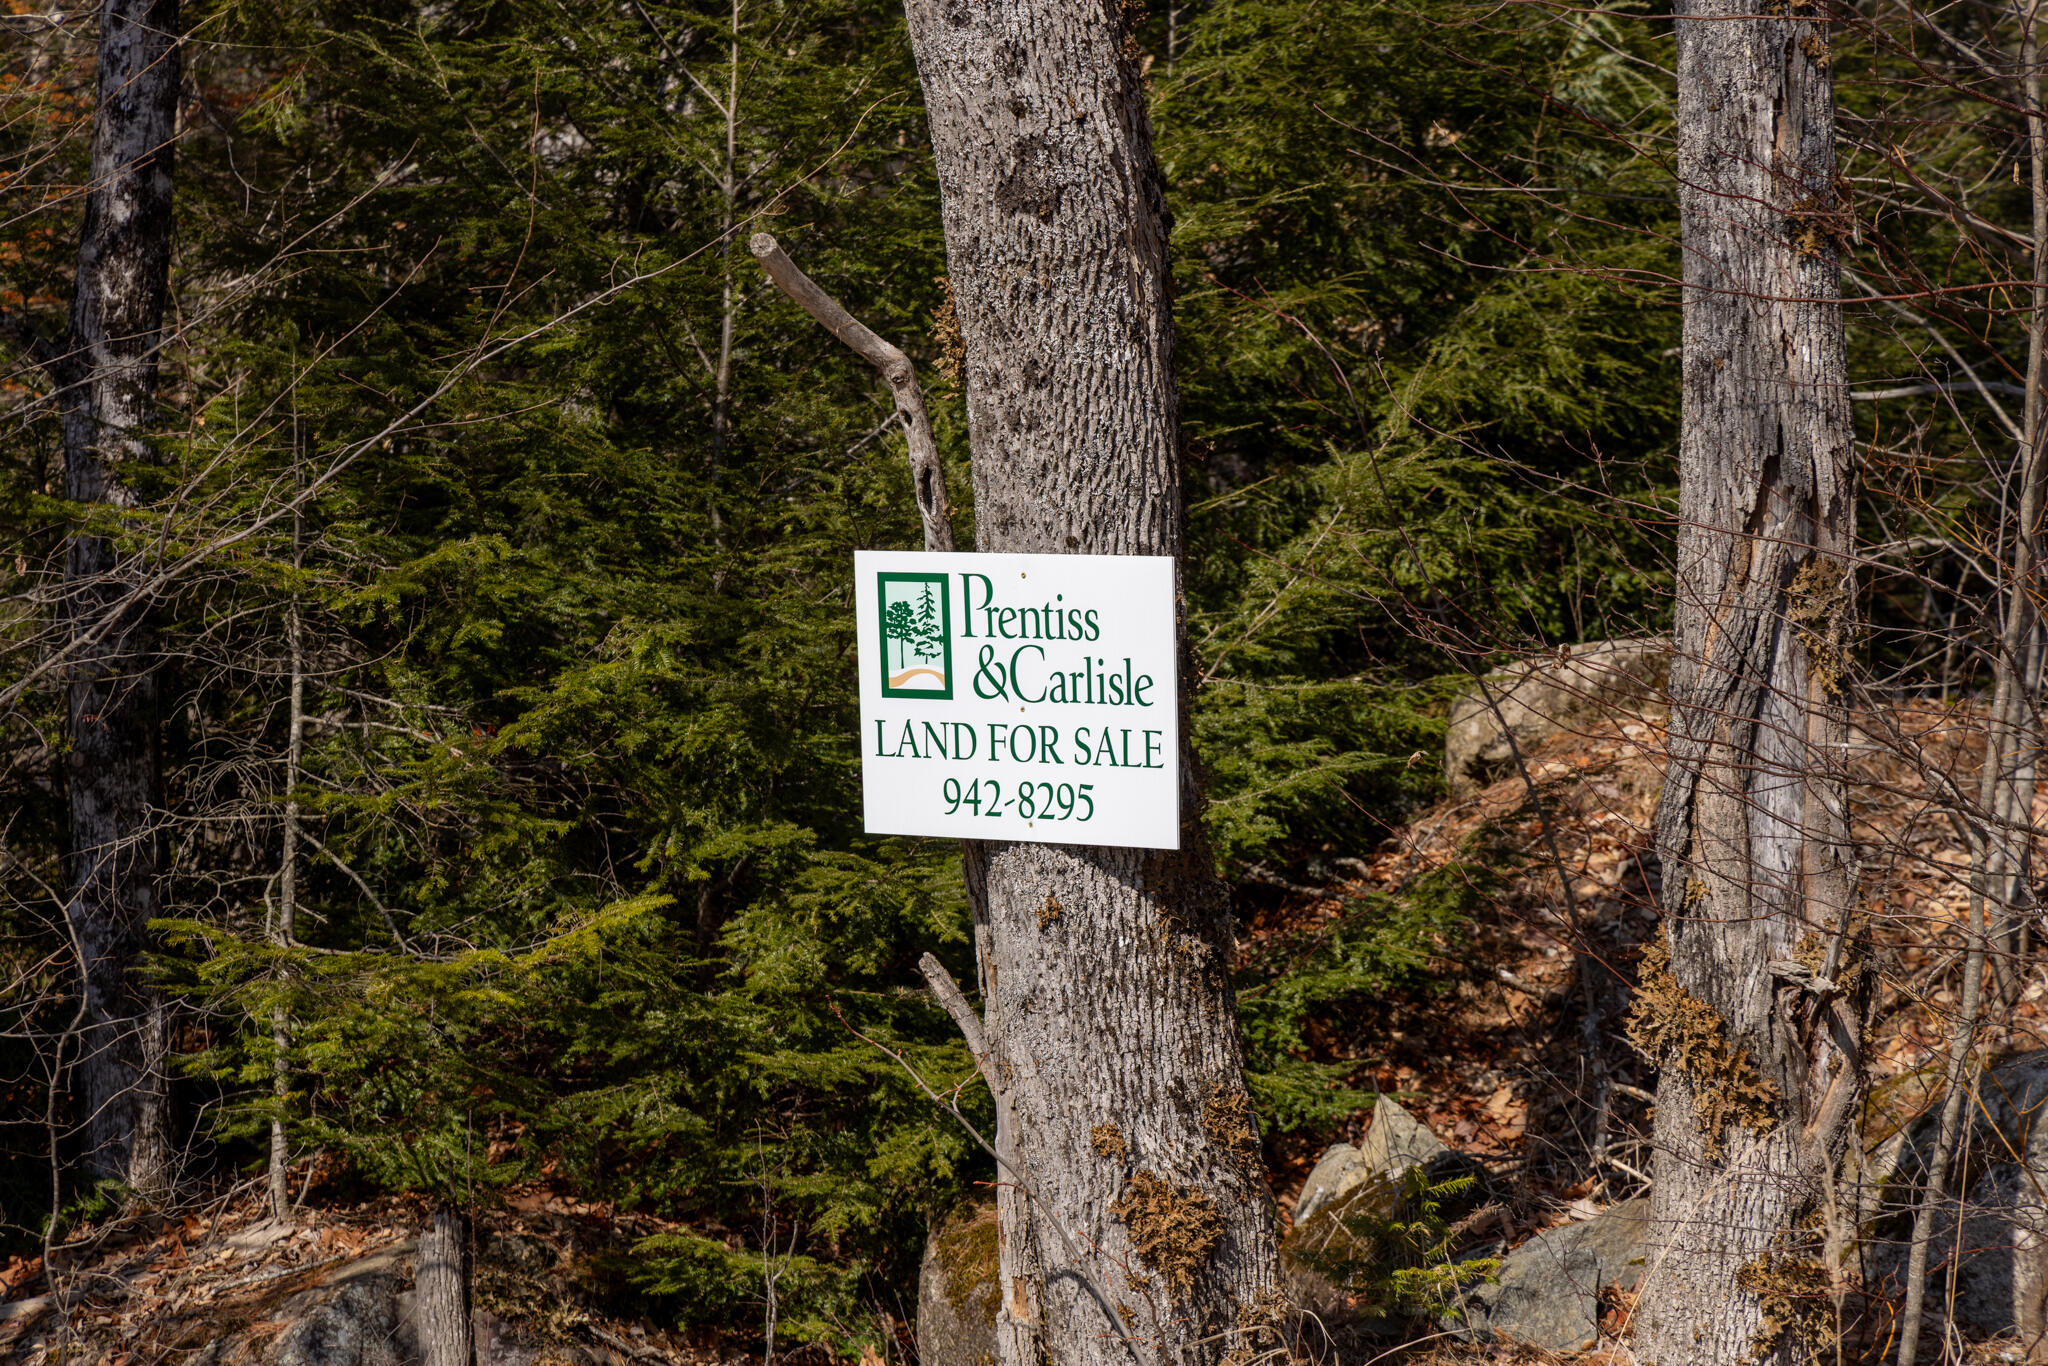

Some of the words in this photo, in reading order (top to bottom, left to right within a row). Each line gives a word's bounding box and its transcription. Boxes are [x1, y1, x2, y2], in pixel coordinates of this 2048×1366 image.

[958, 572, 1101, 642] Prentiss
[874, 718, 978, 761] LAND
[986, 723, 1065, 765] FOR
[1074, 726, 1165, 769] SALE
[943, 777, 1095, 822] 942-8295
